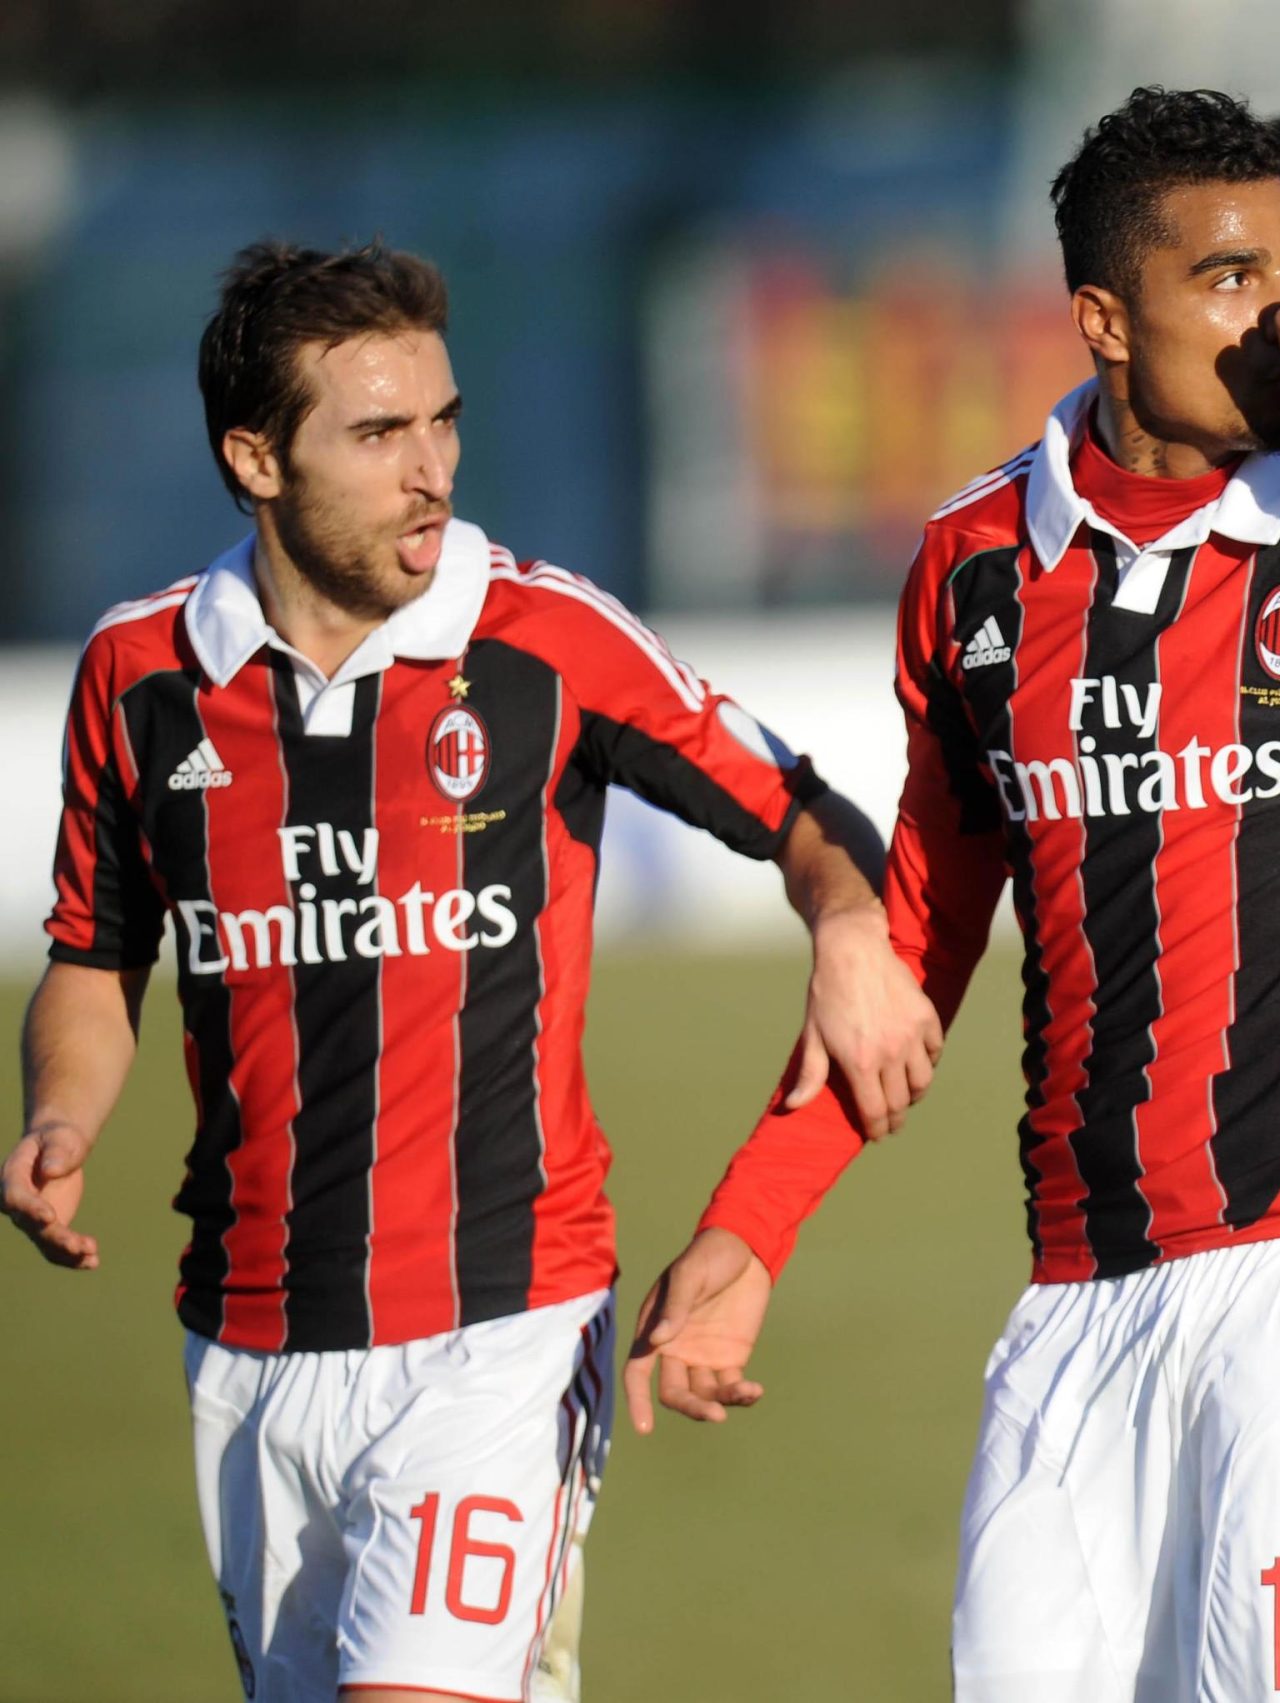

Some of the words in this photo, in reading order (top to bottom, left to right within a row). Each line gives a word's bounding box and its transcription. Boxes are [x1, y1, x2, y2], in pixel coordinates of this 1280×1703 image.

[962, 646, 1011, 670] adidas
[1069, 675, 1162, 738] Fly
[168, 770, 232, 790] adidas
[277, 823, 379, 885] Fly
[177, 880, 518, 975] Emirates
[409, 1491, 524, 1625] 16
